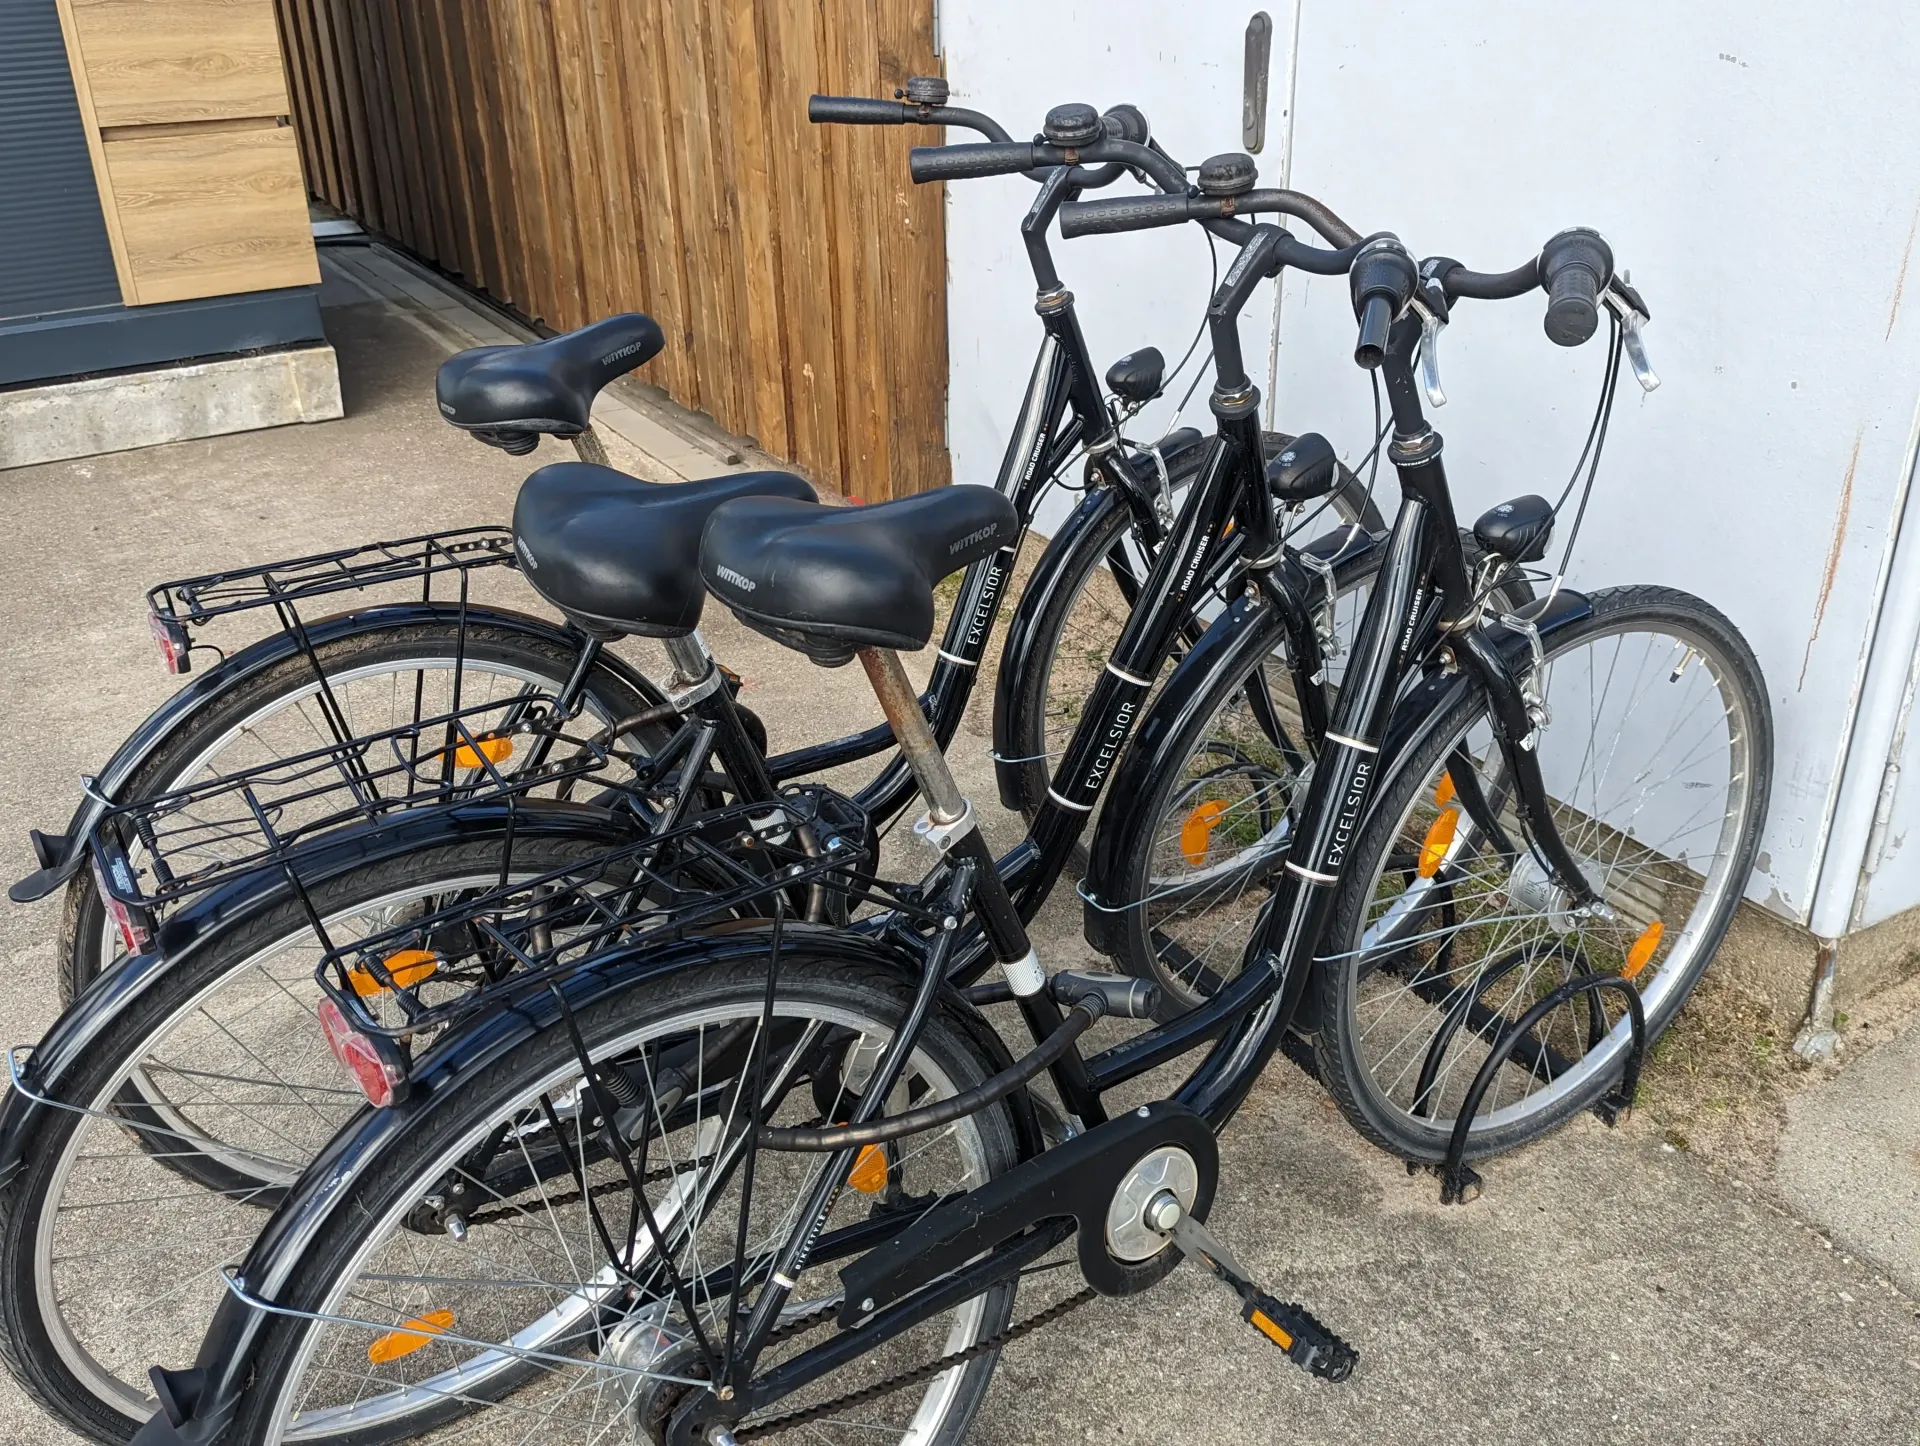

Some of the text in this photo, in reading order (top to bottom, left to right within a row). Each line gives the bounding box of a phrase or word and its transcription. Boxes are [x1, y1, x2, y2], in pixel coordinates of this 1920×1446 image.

[602, 341, 641, 365] WITTKOP
[1025, 432, 1046, 480] ROAD CRUISER
[949, 522, 997, 555] WITTKOP
[1180, 535, 1210, 591] ROAD CRUISER
[716, 564, 756, 592] WITTKOP
[967, 566, 1002, 645] EXCELSIOR
[1401, 588, 1423, 651] ROAD CRUISER
[1085, 702, 1136, 789] EXCELSIOR
[1327, 763, 1371, 866] EXCELSIOR
[794, 1214, 826, 1270] BIKESTYLE
